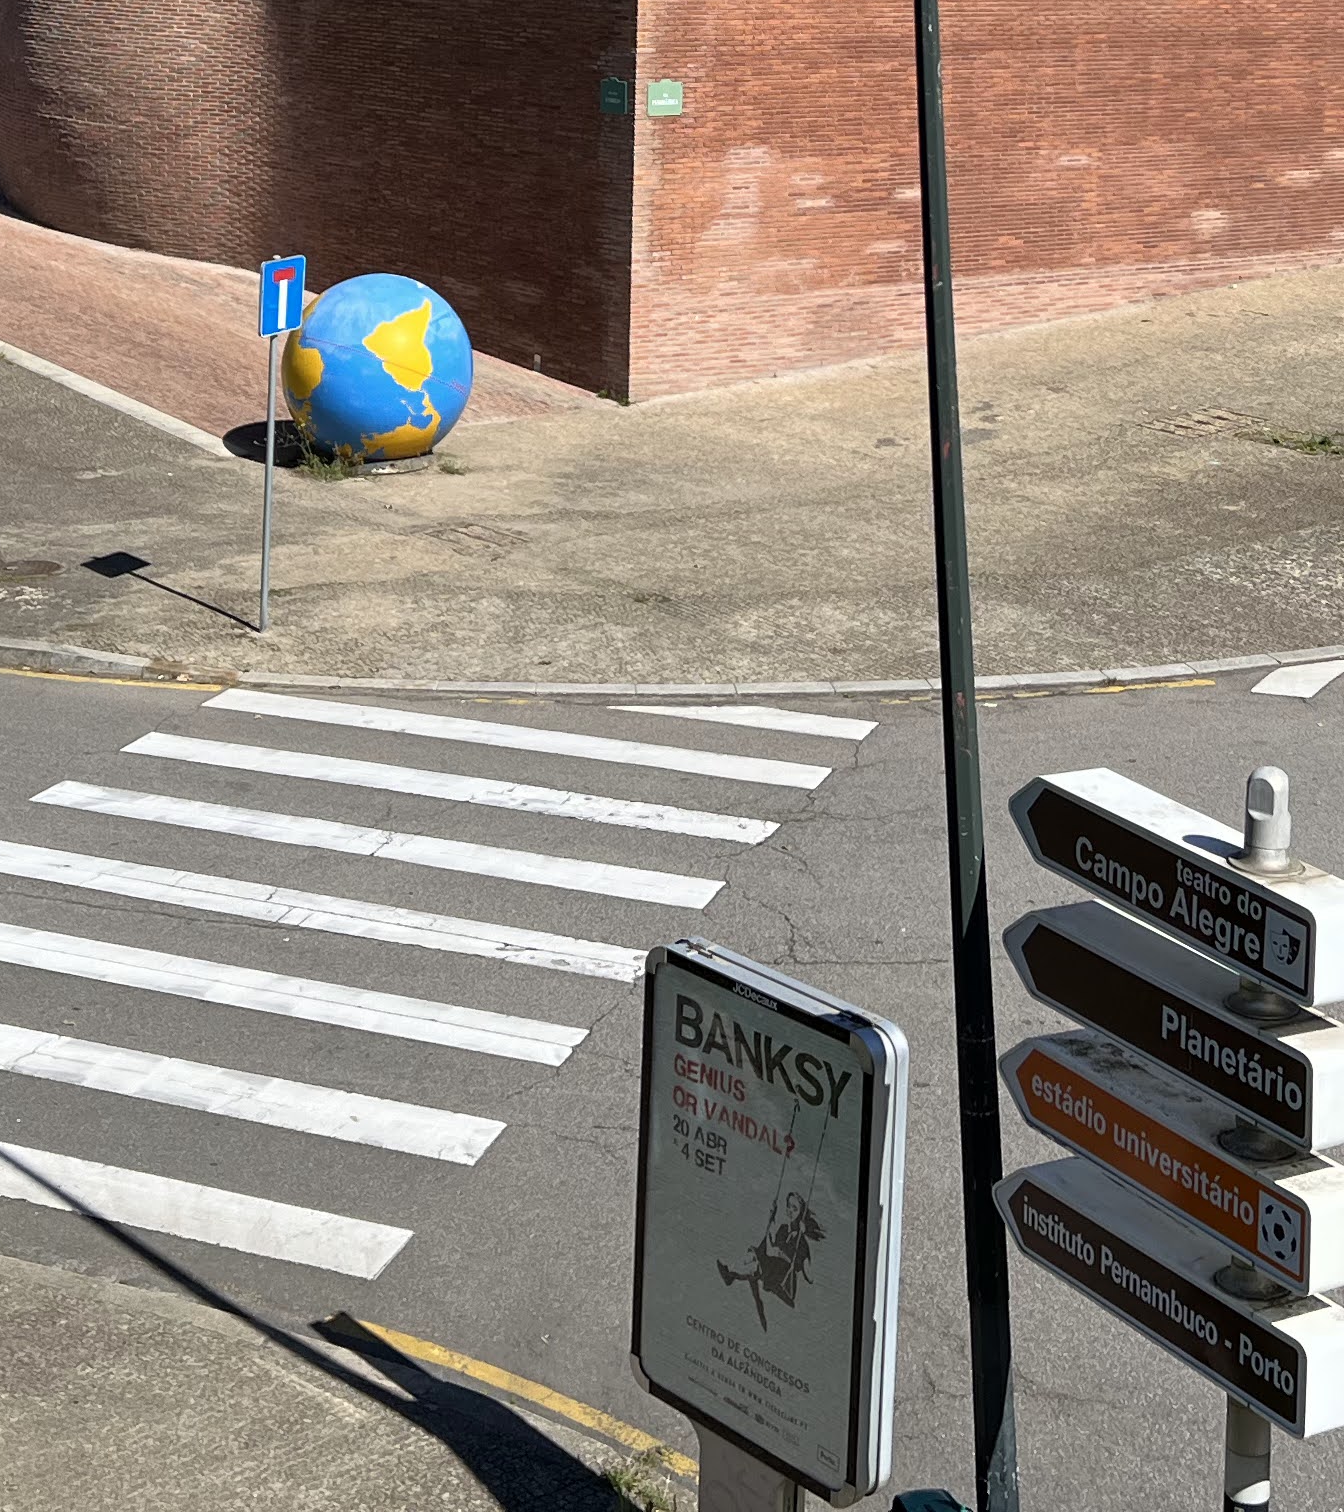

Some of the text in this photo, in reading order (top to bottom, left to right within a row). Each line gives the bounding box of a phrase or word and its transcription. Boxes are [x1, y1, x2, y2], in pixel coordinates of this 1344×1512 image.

[1075, 835, 1262, 961] Campo Alegre
[1176, 858, 1262, 921] teatro do
[733, 982, 778, 1011] JCDecaux
[674, 1053, 746, 1102] GENIUS
[675, 993, 853, 1119] BANKSY
[1161, 1005, 1303, 1111] Planetário
[673, 1085, 796, 1159] OR VANDAL?
[673, 1114, 727, 1155] 20 ABR
[681, 1143, 727, 1175] 4 SET
[1031, 1073, 1255, 1226] estádio universitário
[1023, 1195, 1095, 1266] instituto
[1101, 1244, 1218, 1345] Pernambuco
[1238, 1333, 1295, 1396] Porto
[686, 1315, 810, 1394] CENTRO DE CONGRESSOS
[711, 1347, 782, 1397] DA ALFÂNDEGA
